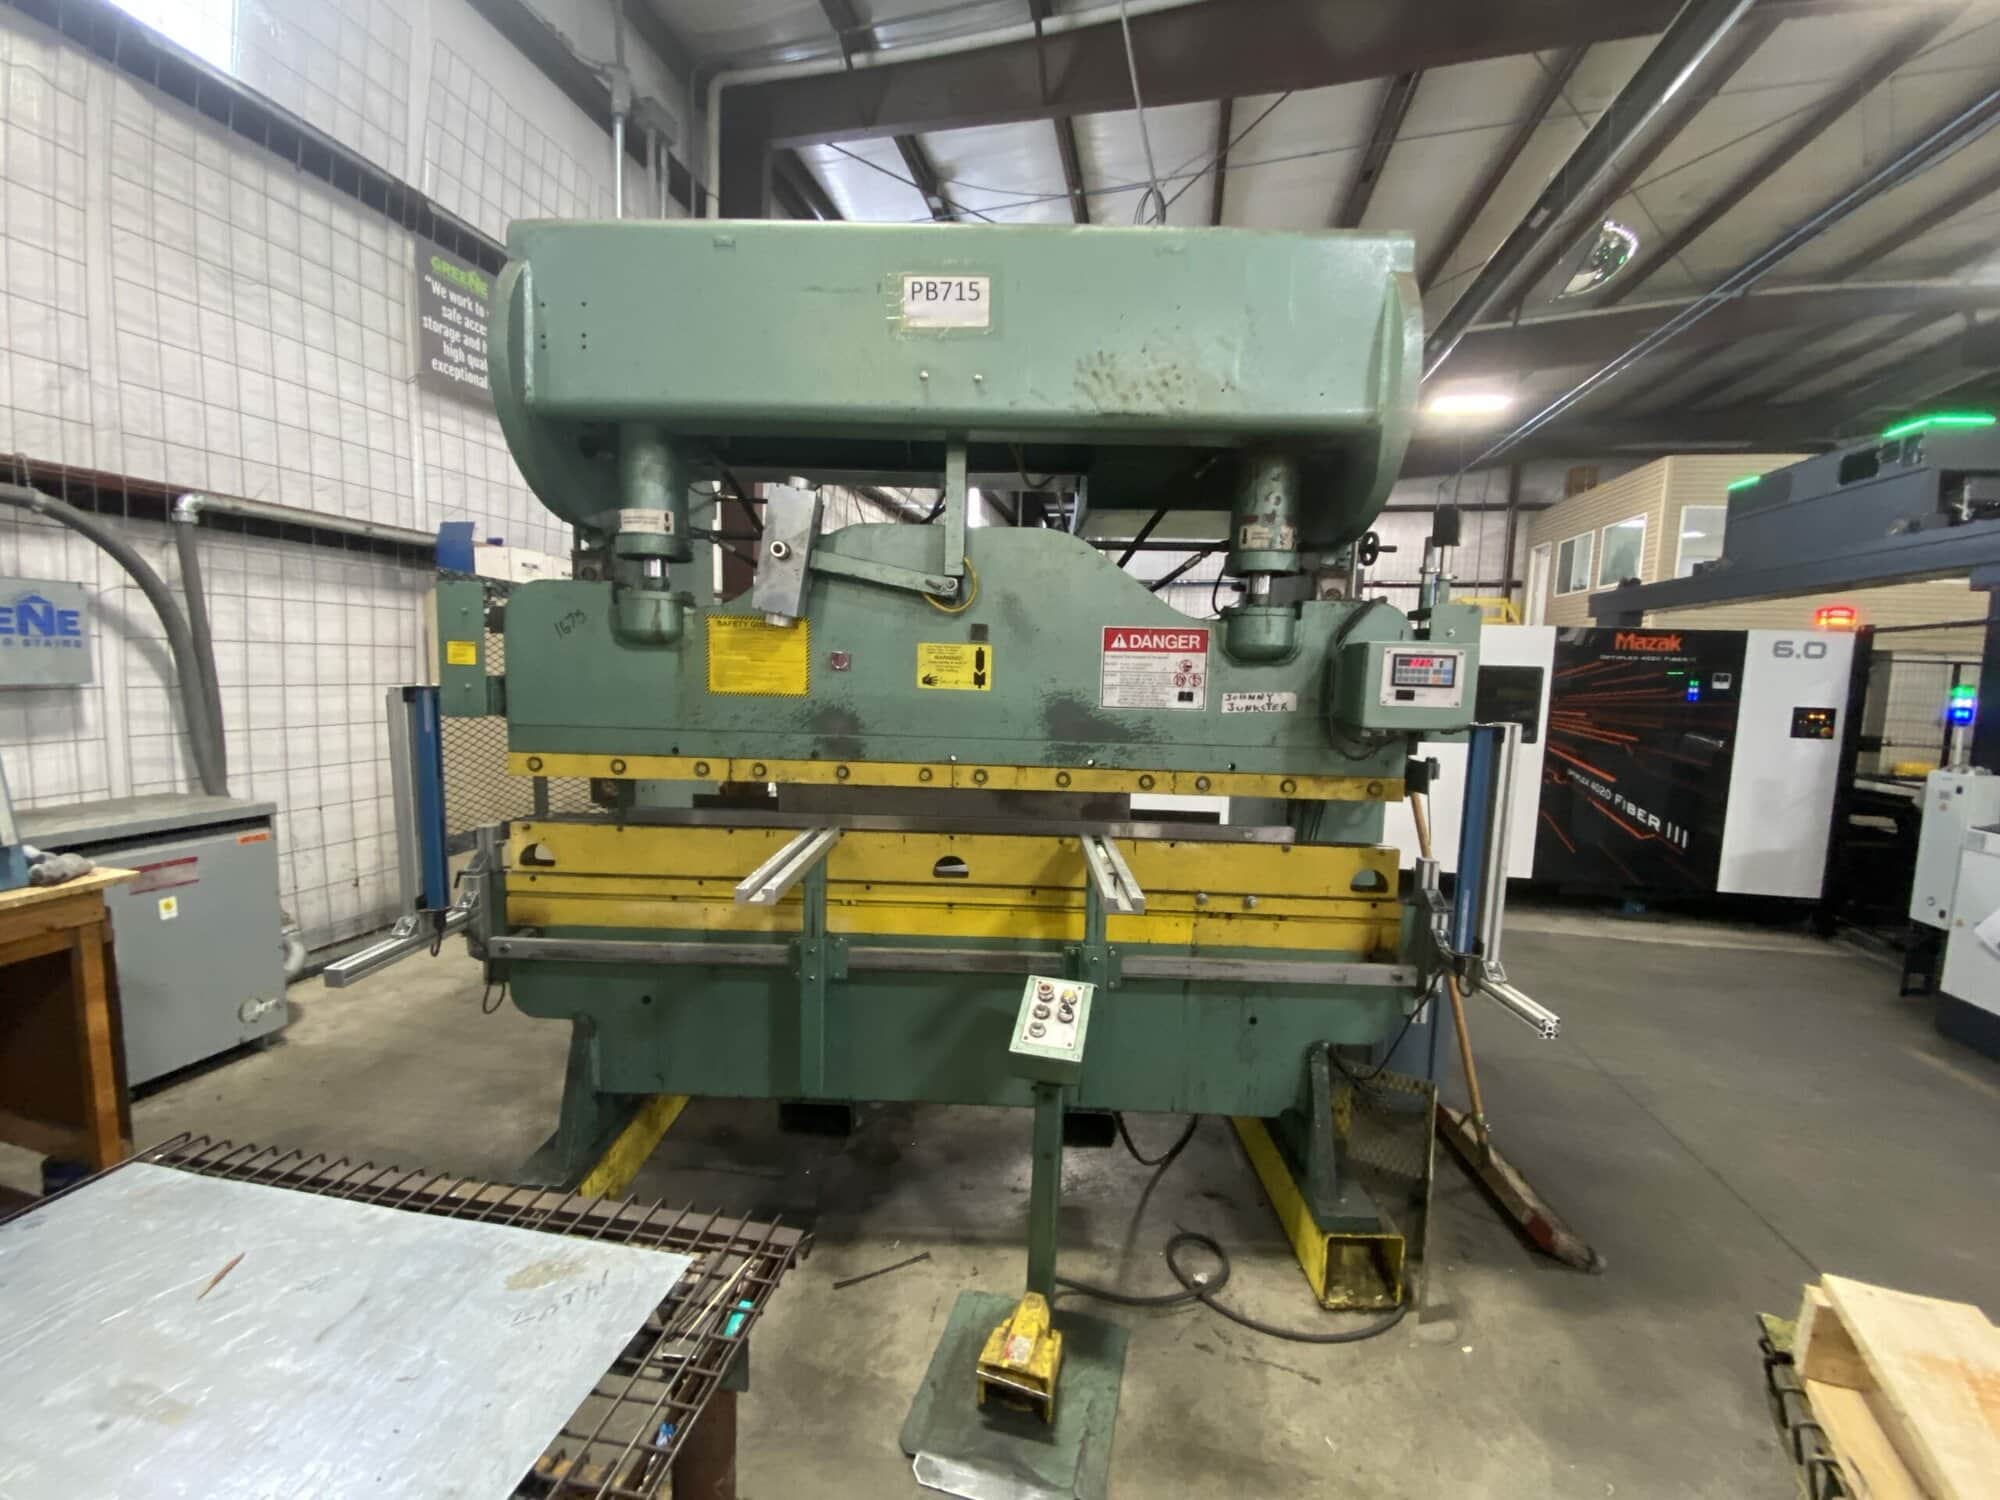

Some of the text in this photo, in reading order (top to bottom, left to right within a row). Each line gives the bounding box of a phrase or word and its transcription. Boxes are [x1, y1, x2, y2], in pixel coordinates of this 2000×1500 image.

[448, 289, 473, 312] work
[911, 281, 980, 301] PB715
[441, 305, 462, 324] safe
[422, 316, 461, 343] storage
[463, 333, 480, 352] and
[443, 341, 465, 363] high
[432, 358, 488, 390] exceptional
[1129, 634, 1200, 649] DANGER
[1615, 632, 1682, 652] Mazak
[1773, 641, 1827, 659] 6.0
[1614, 793, 1661, 832] FIBER
